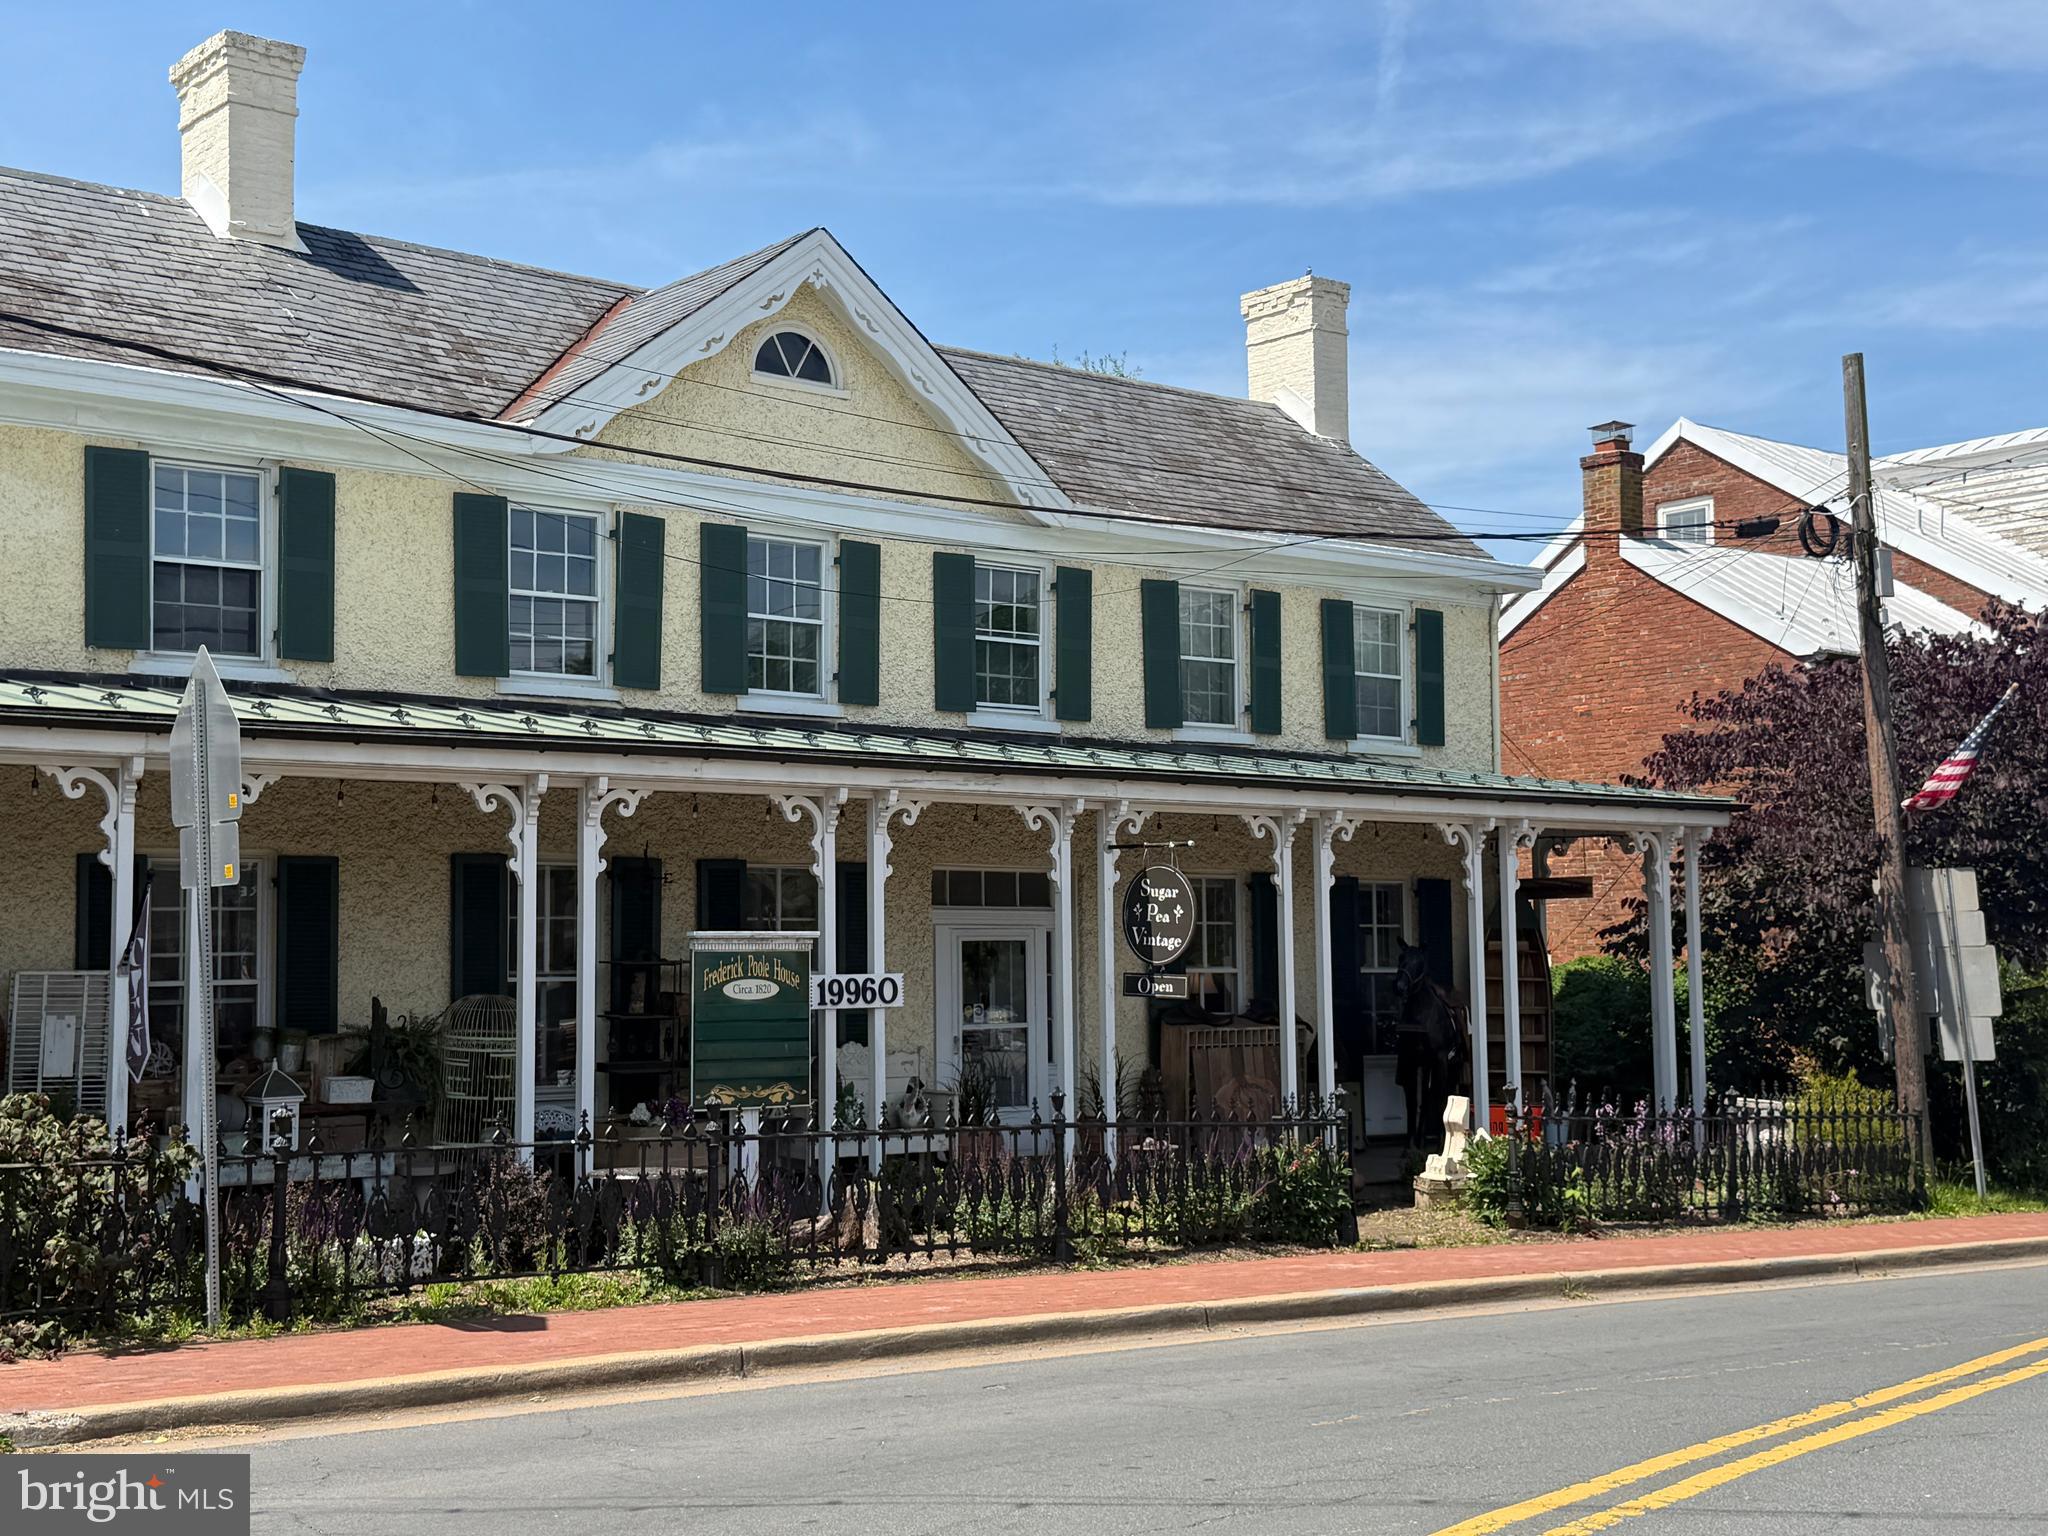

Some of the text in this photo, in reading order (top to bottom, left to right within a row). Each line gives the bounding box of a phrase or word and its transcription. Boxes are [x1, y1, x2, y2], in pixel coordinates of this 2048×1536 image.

[1140, 879, 1179, 901] Sugar
[1147, 904, 1170, 923] Pea
[1132, 927, 1182, 950] Vintage
[703, 954, 800, 992] Frederick Poole House
[732, 983, 772, 995] Circa 1820
[816, 976, 899, 1007] 19960
[1137, 977, 1173, 994] Open
